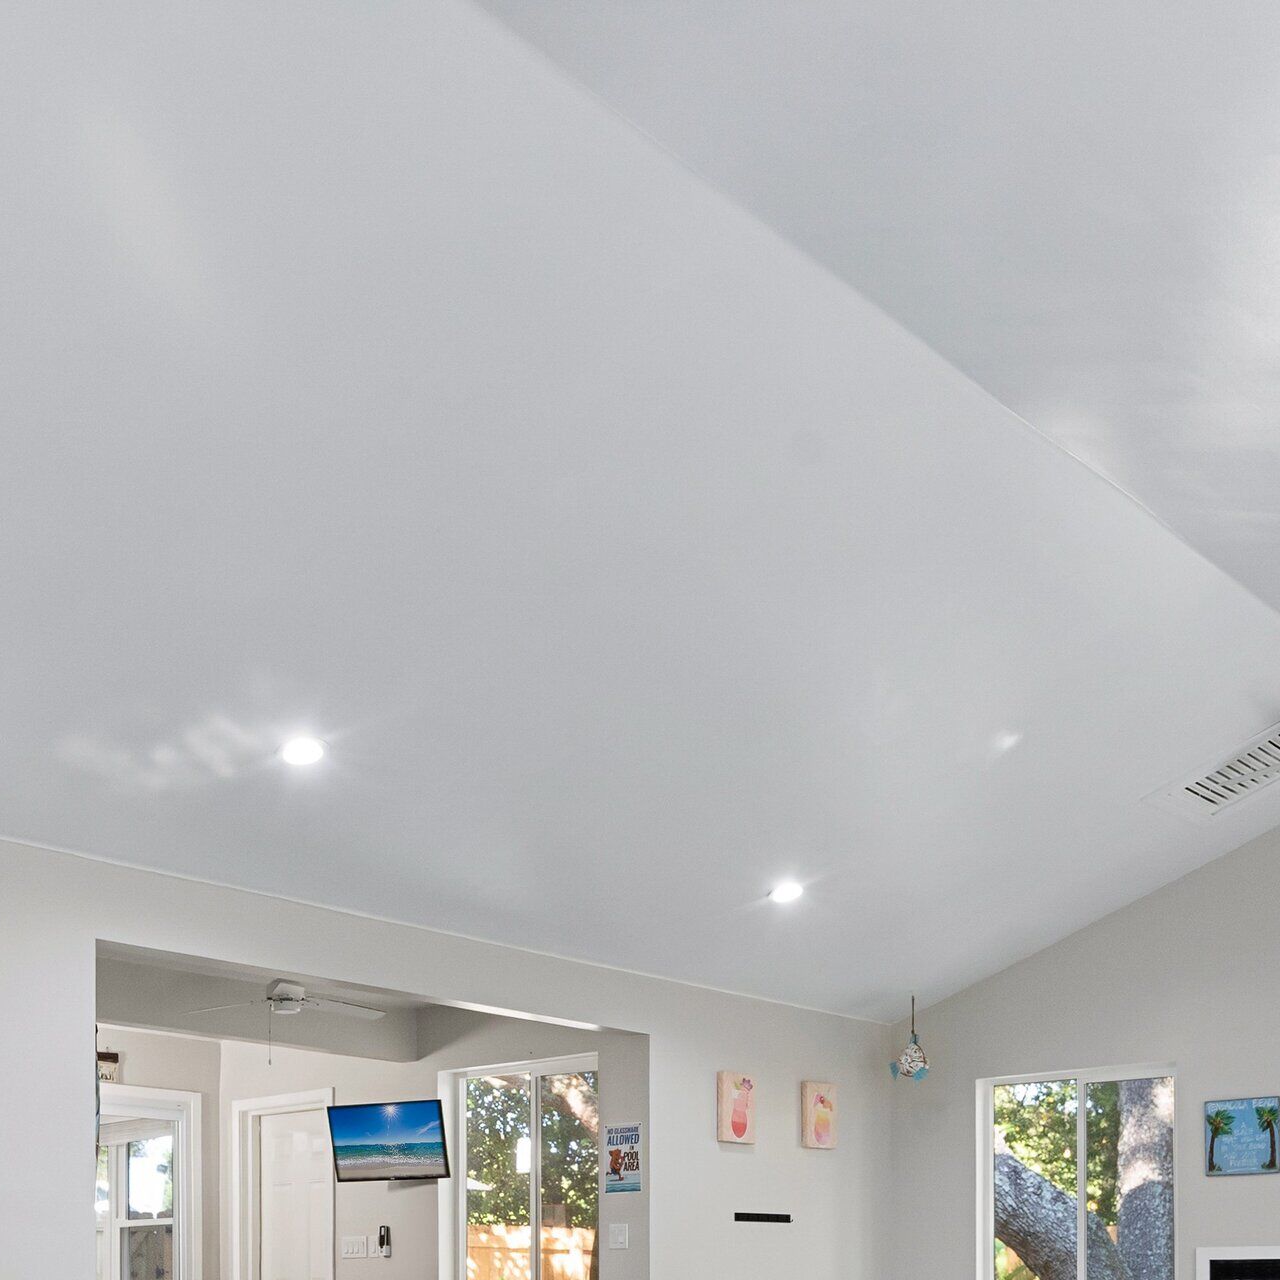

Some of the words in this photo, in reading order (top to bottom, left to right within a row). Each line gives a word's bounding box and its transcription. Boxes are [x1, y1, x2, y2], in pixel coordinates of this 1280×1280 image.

[607, 1134, 640, 1146] ALLOWED
[623, 1151, 640, 1161] POOL
[623, 1162, 640, 1171] AREA
